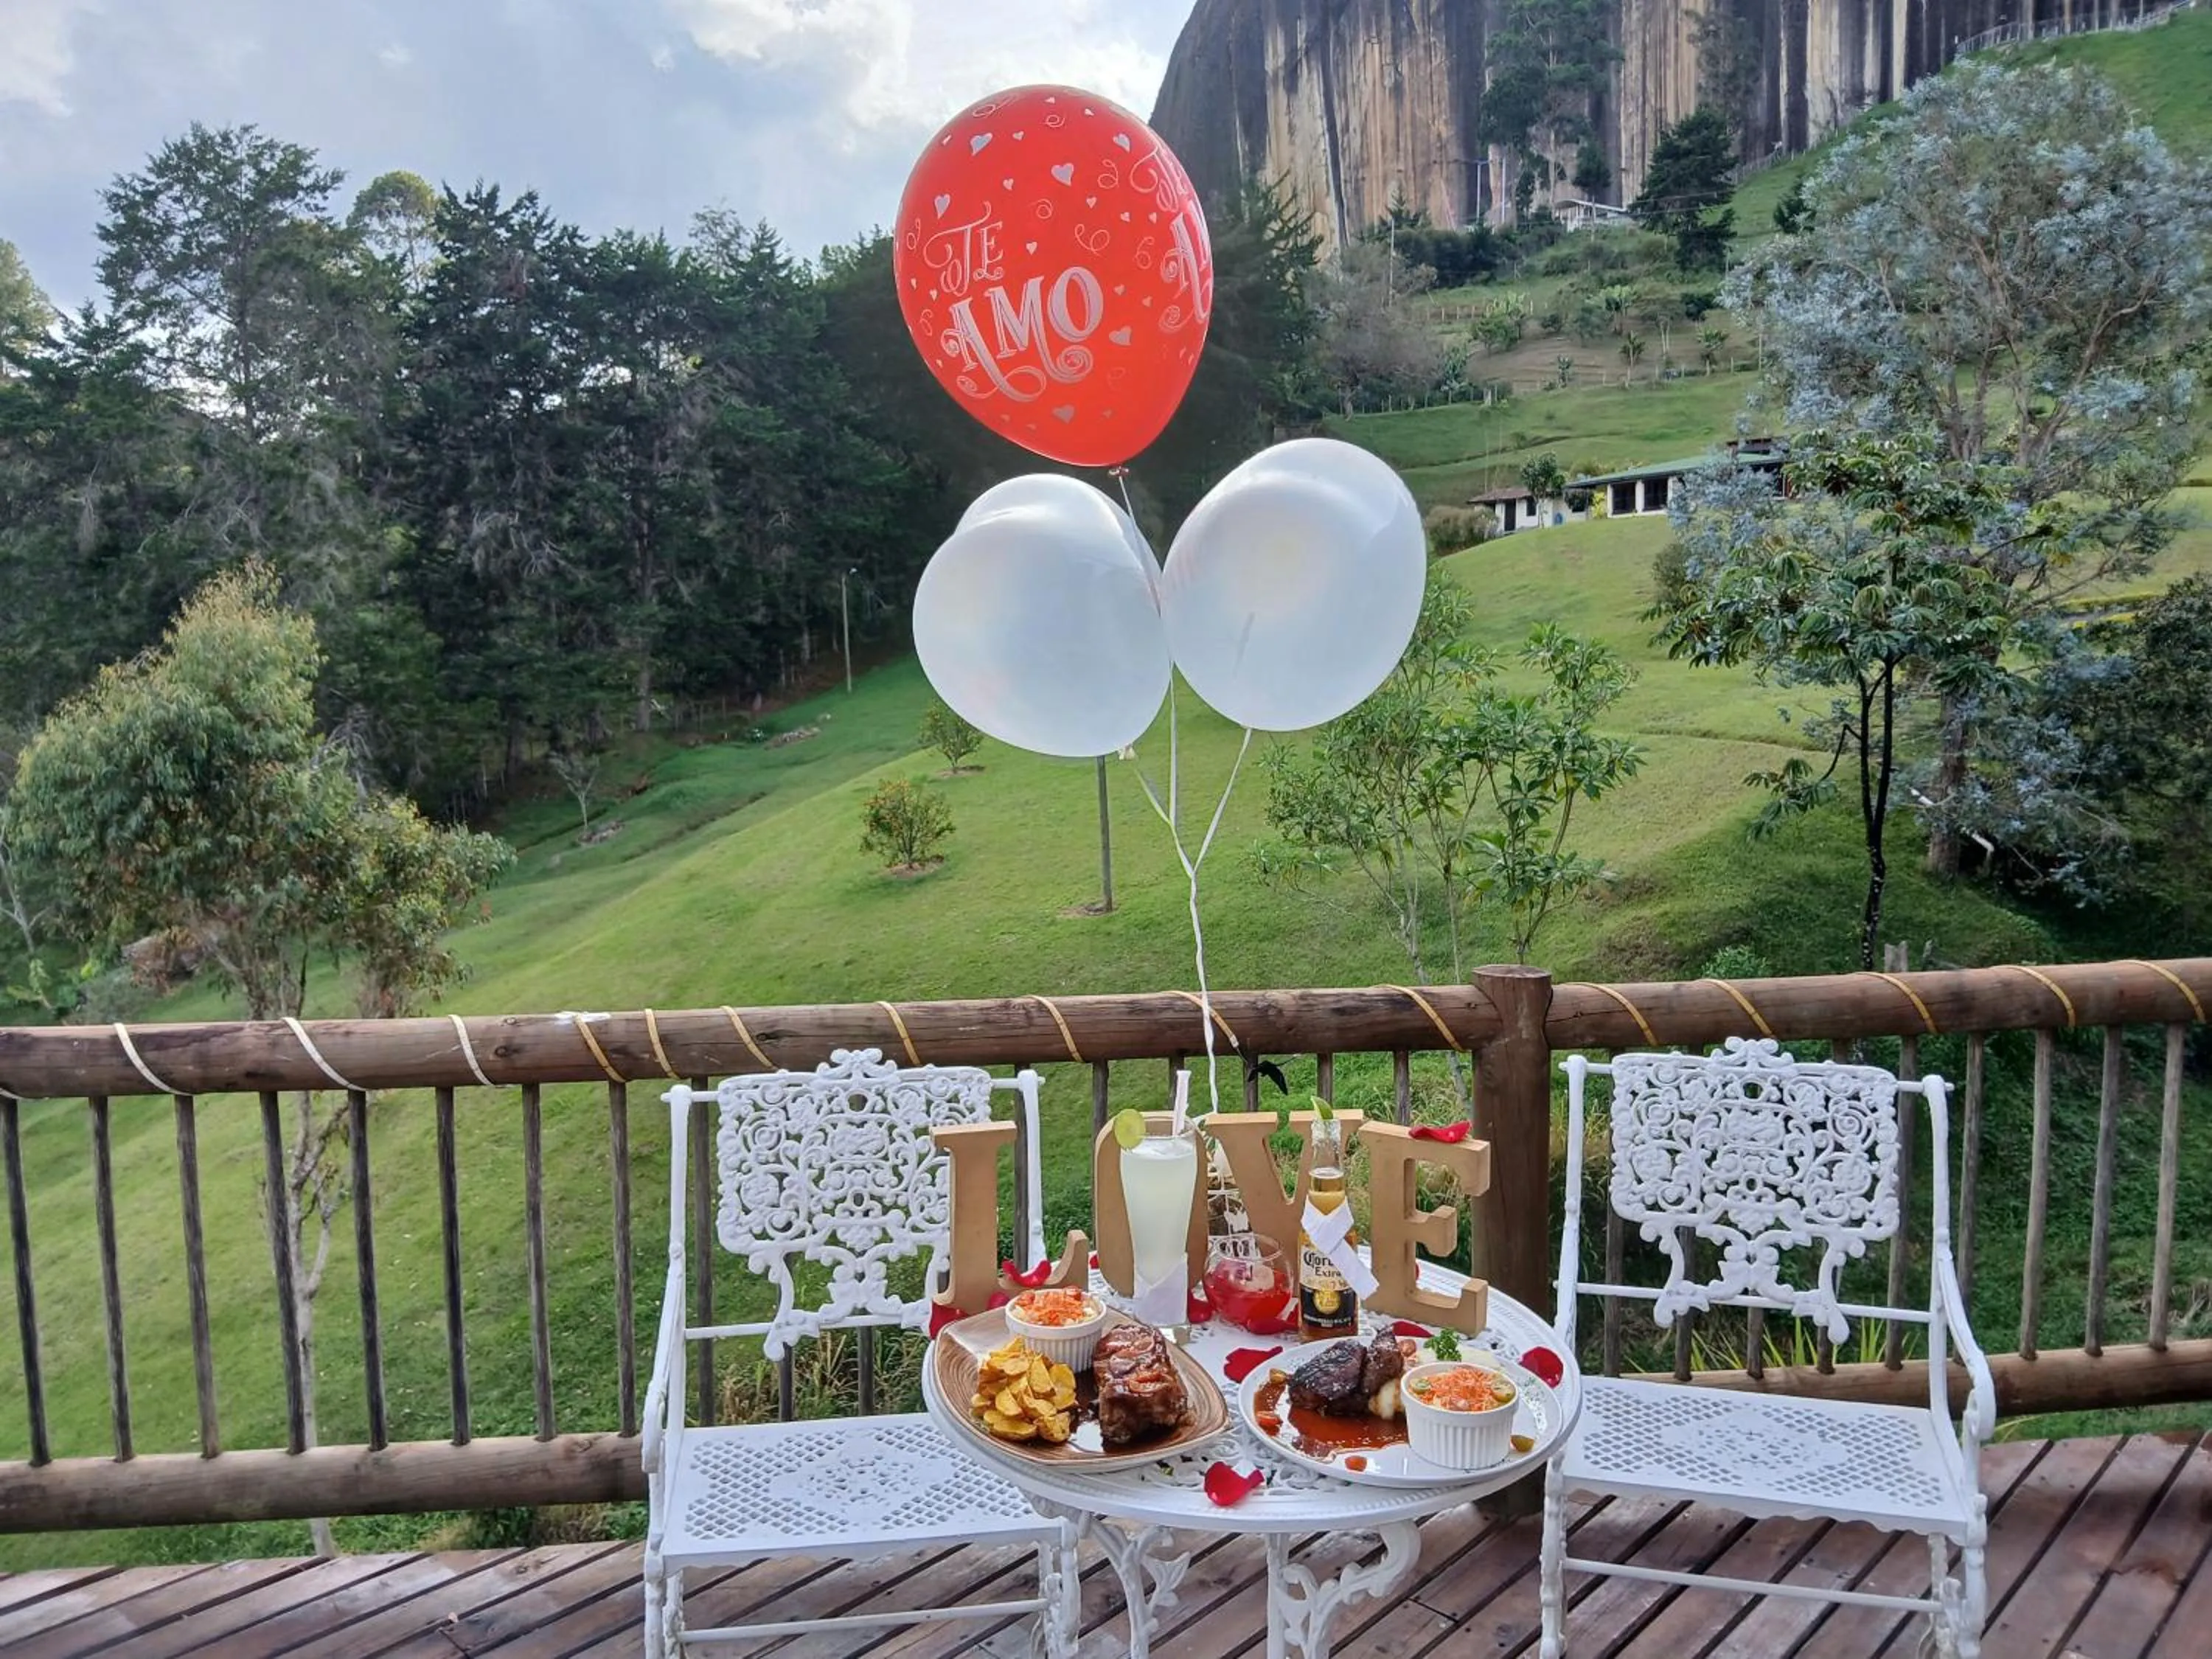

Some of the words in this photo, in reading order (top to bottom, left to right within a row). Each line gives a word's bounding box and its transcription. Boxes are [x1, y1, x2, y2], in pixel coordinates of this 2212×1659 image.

[923, 201, 1004, 296] TE
[941, 265, 1105, 403] AMO
[931, 1109, 1491, 1338] LOVE
